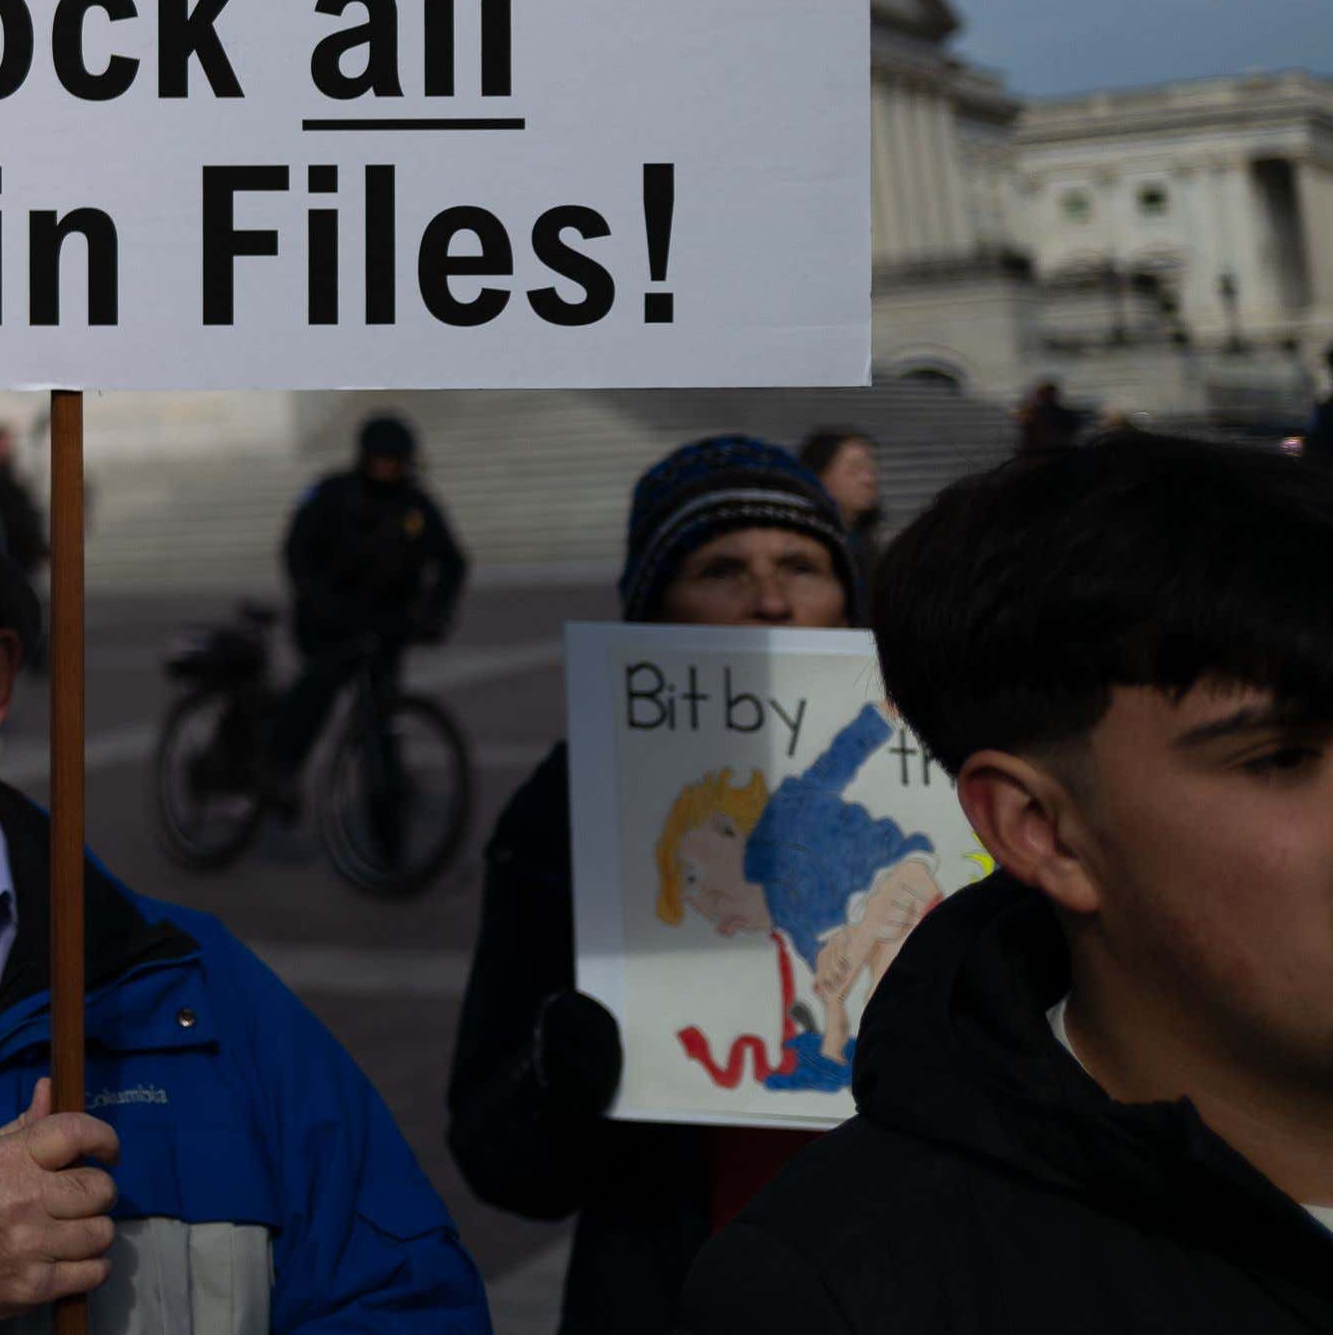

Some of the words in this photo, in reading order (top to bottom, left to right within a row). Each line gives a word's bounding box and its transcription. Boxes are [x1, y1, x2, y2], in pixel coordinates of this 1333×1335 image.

[202, 162, 675, 326] Files!
[626, 661, 711, 731] Bit
[724, 665, 807, 758] by
